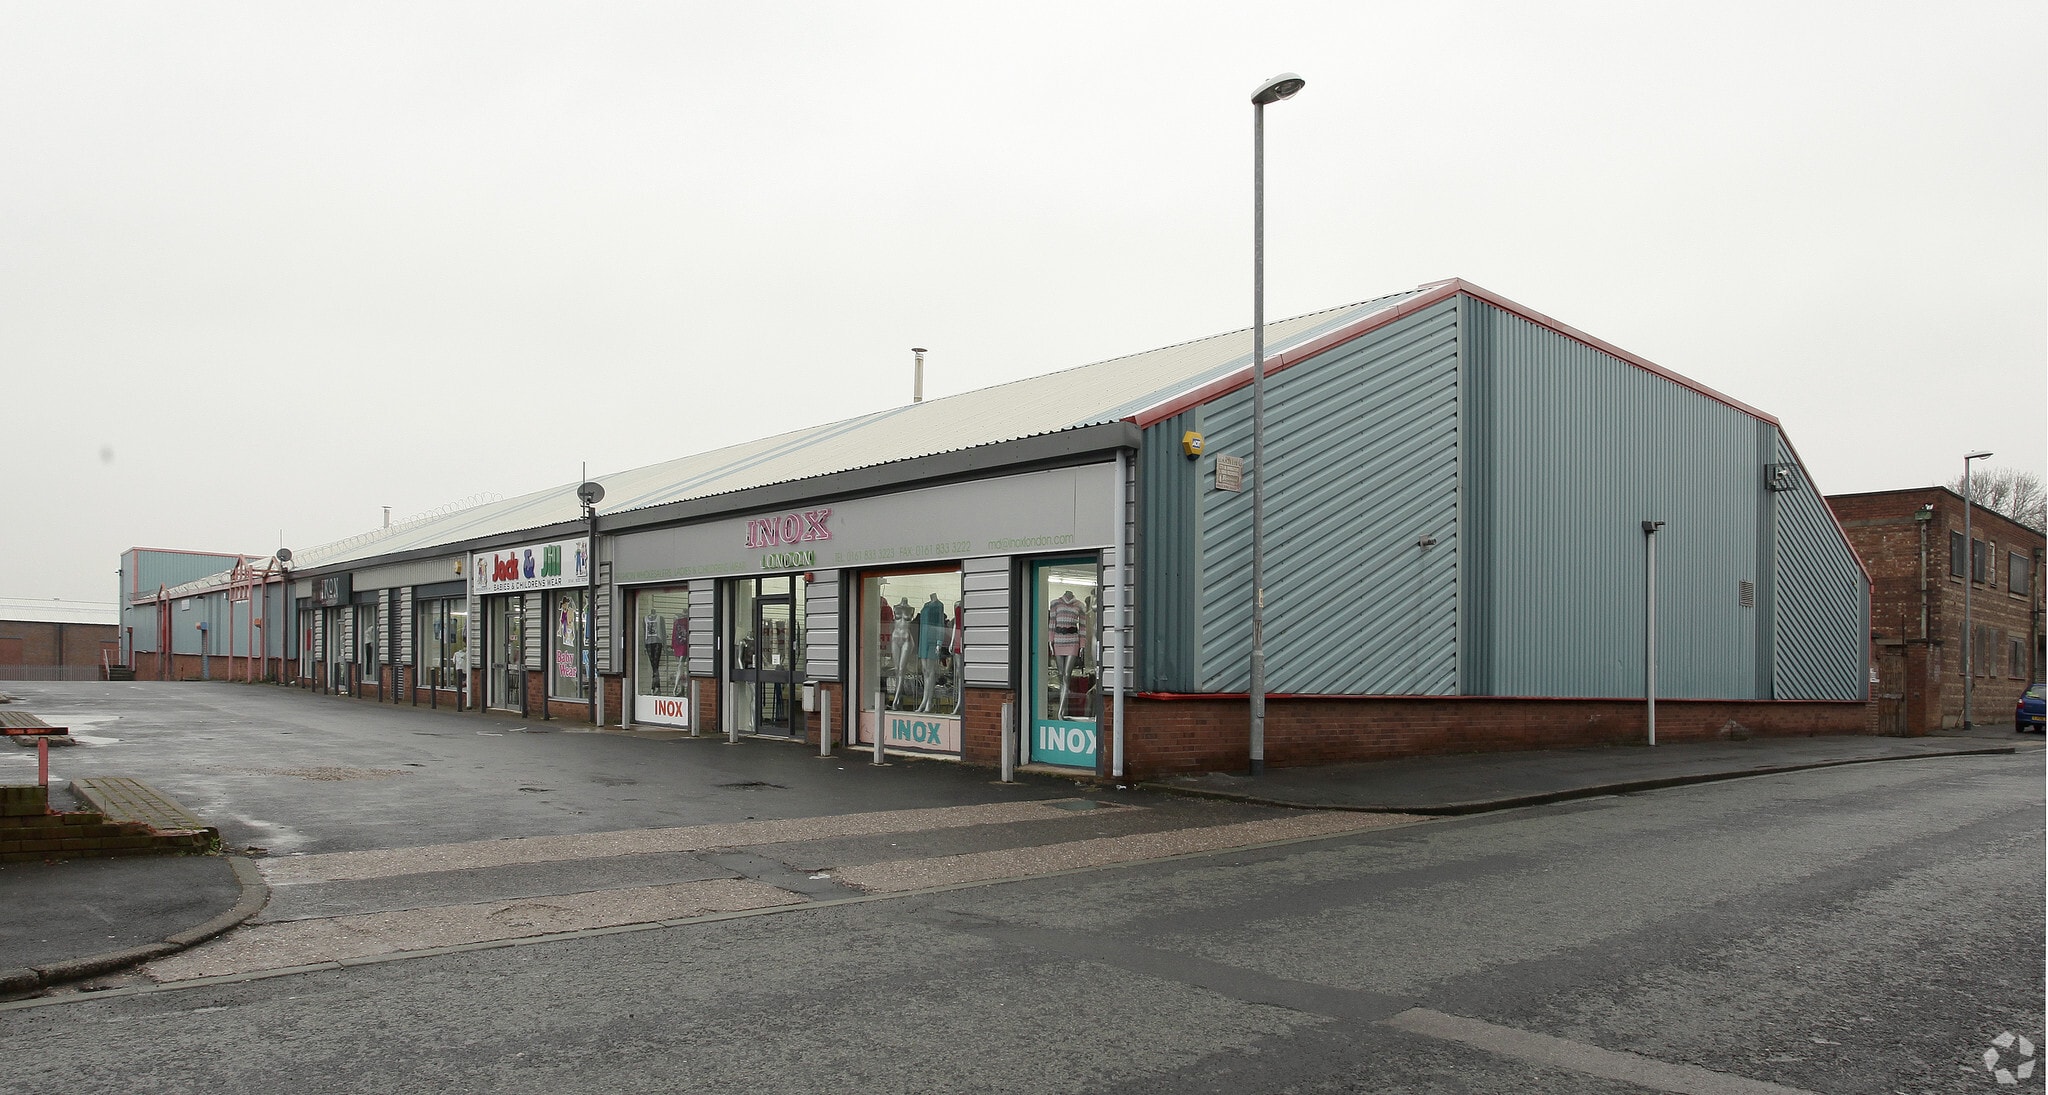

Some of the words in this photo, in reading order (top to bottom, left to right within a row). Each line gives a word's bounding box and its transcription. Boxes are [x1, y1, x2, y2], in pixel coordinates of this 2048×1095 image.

[744, 508, 832, 549] INOX
[761, 550, 815, 569] LONDON
[847, 550, 862, 561] 0161
[915, 545, 933, 556] 0161
[935, 542, 950, 554] 833
[951, 540, 971, 553] 3222
[492, 551, 519, 582] Jack
[523, 548, 536, 579] &
[541, 544, 562, 578] Jill
[493, 582, 510, 592] BABIES
[516, 579, 546, 589] CHILDRENS
[547, 577, 562, 586] WEAR
[556, 649, 574, 666] Baby
[560, 664, 577, 678] Wear
[655, 699, 683, 717] INOX
[892, 719, 941, 744] INOX
[1039, 726, 1096, 754] INOX
